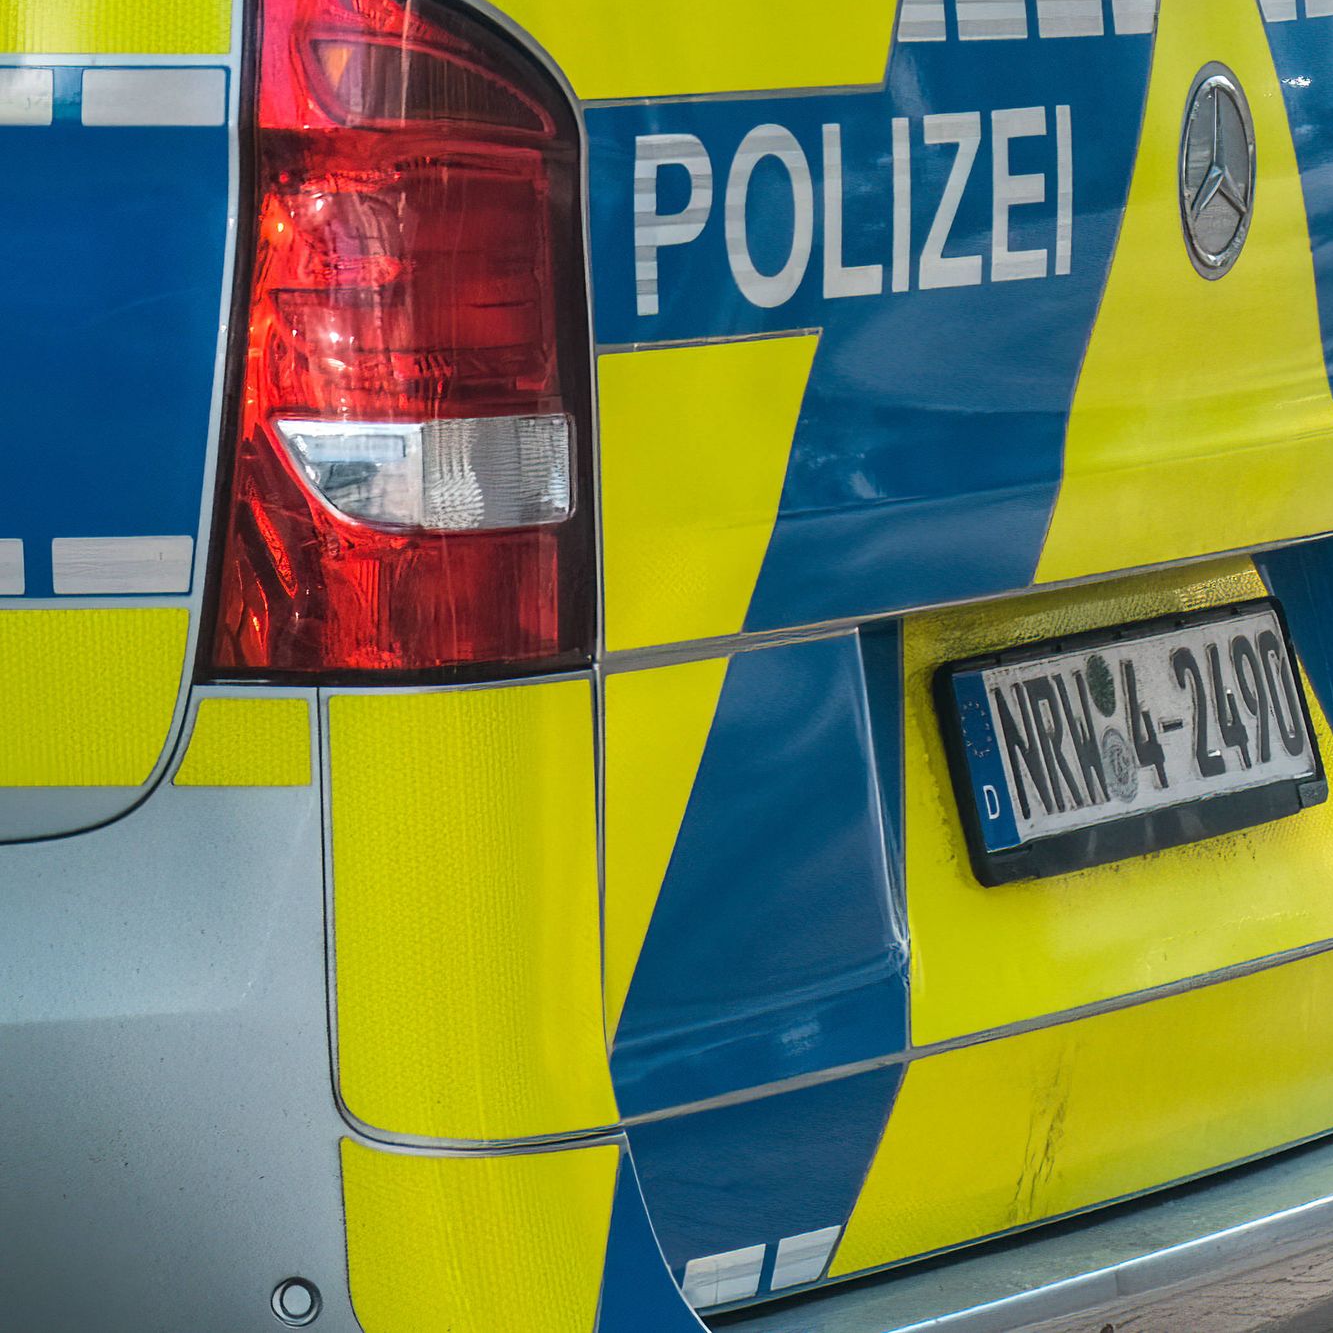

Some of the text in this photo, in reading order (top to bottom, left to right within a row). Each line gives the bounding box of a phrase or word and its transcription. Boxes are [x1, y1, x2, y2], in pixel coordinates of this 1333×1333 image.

[634, 104, 1073, 316] POLIZEI
[982, 630, 1304, 820] D NRW 4-2490
